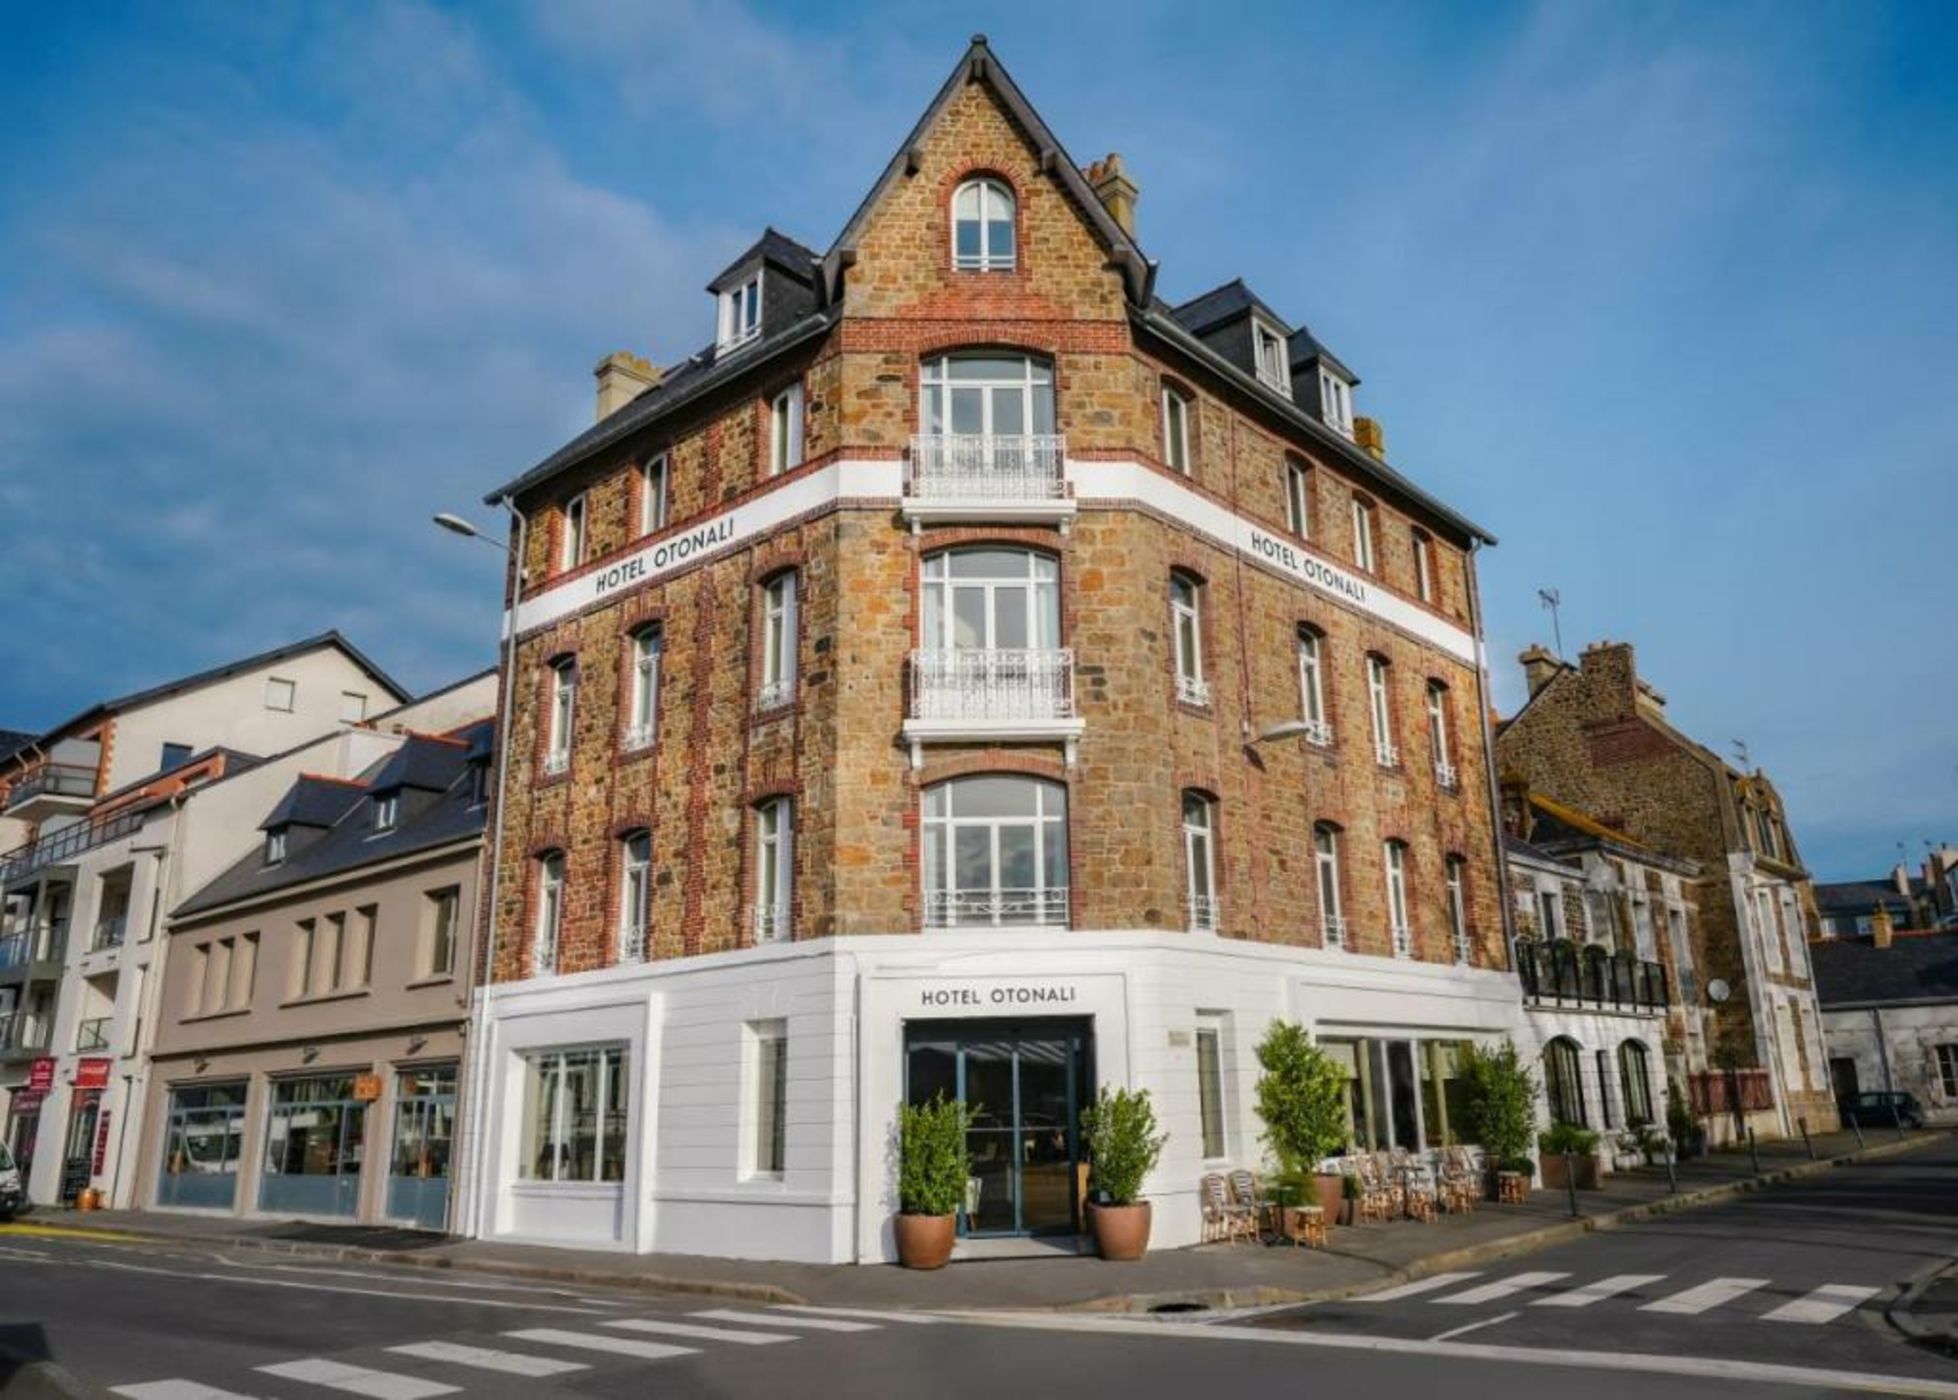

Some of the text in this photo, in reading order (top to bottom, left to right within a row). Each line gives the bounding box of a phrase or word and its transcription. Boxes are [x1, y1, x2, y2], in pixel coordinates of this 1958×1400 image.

[596, 517, 734, 594] HOTEL OTONALI
[1251, 531, 1366, 601] HOTEL OTONALI
[922, 987, 1076, 1005] HOTEL OTONALI
